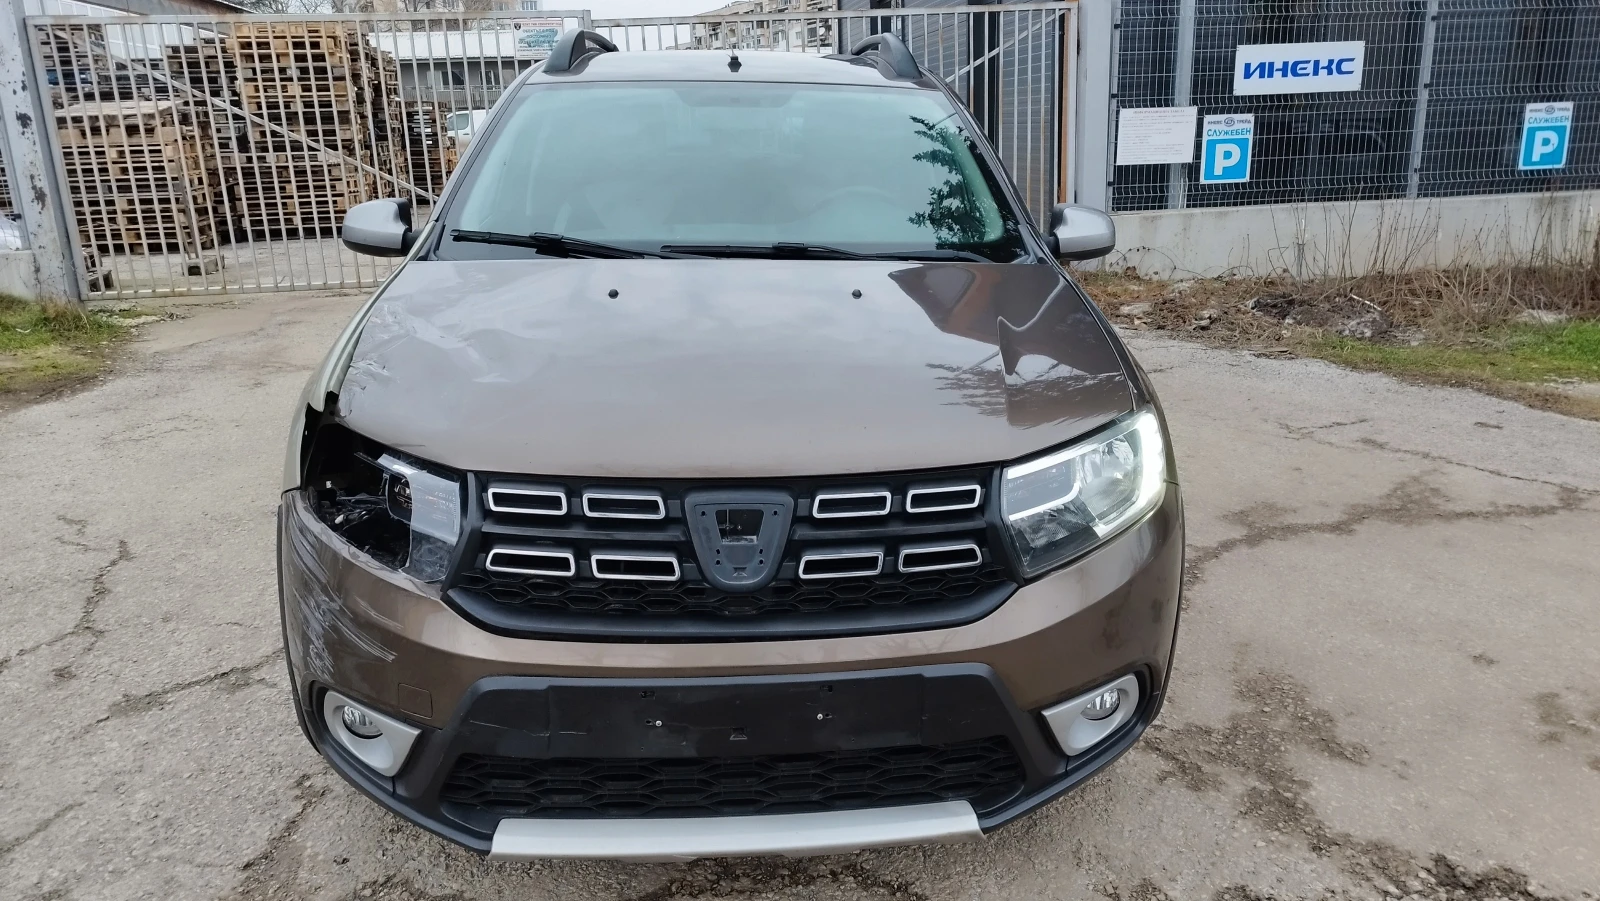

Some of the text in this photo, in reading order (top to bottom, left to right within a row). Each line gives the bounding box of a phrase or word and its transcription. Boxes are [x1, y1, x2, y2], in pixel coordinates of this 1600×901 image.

[1243, 58, 1356, 79] ИНЕКС
[1528, 115, 1569, 124] СЛУЖЕБЕН
[1207, 127, 1252, 137] СЛУЖЕБЕН
[1531, 130, 1559, 162] P
[1213, 143, 1241, 176] P
